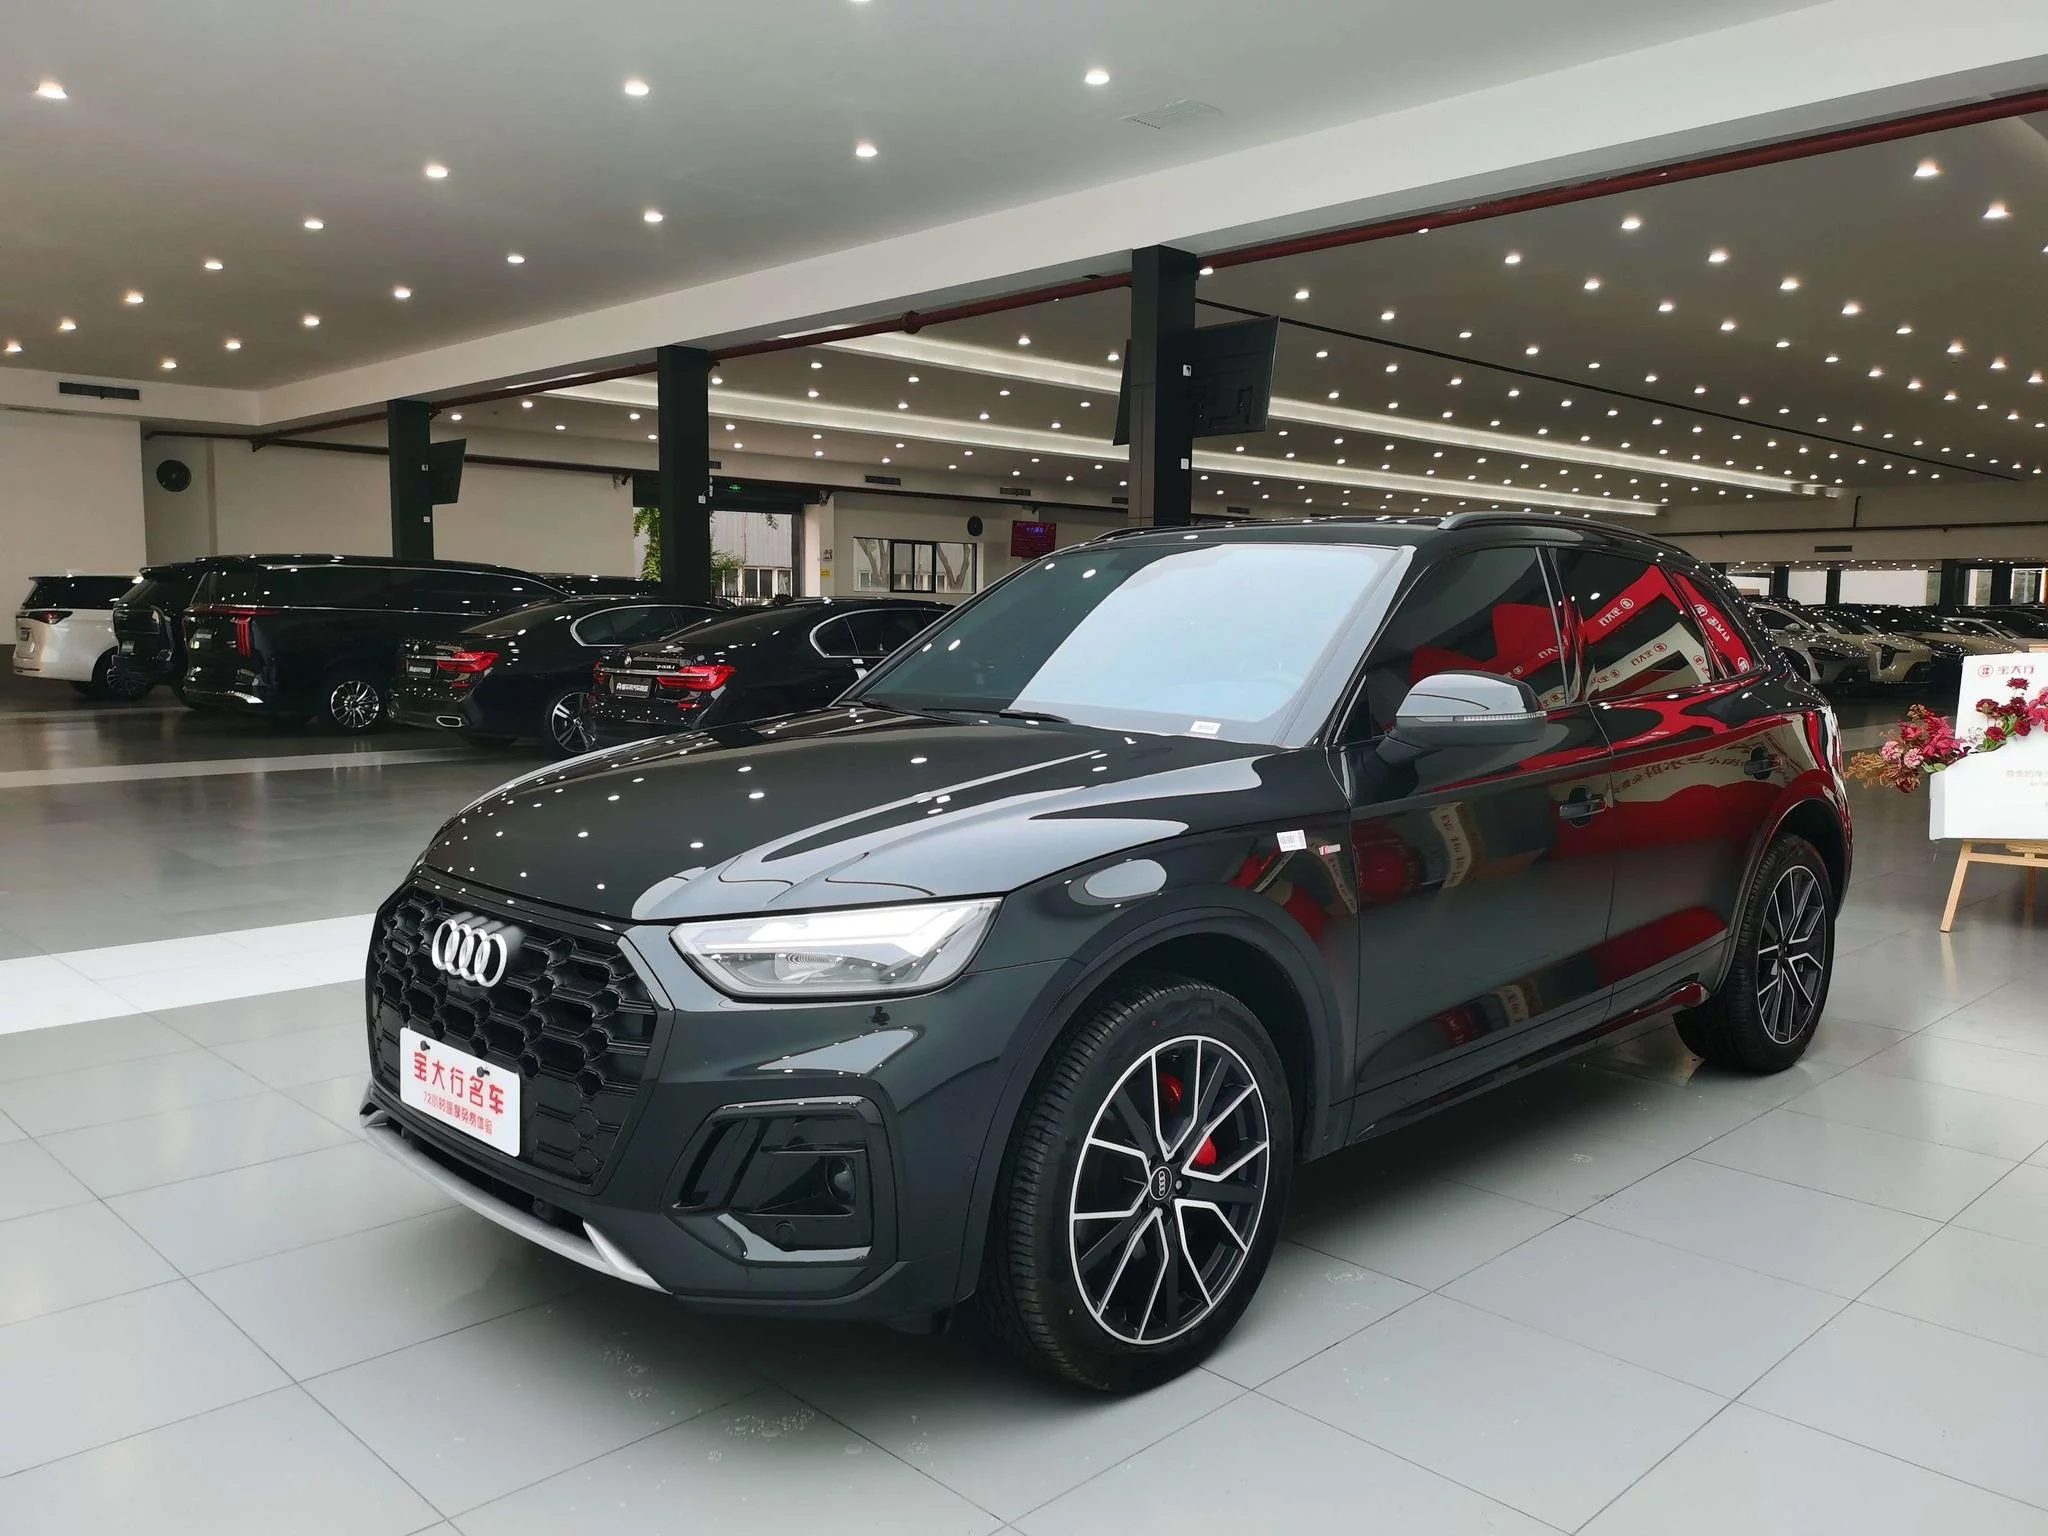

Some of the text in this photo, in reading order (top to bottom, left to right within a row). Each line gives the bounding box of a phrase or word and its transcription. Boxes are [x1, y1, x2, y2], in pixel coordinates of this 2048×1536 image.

[414, 1052, 504, 1114] 宝大行名车
